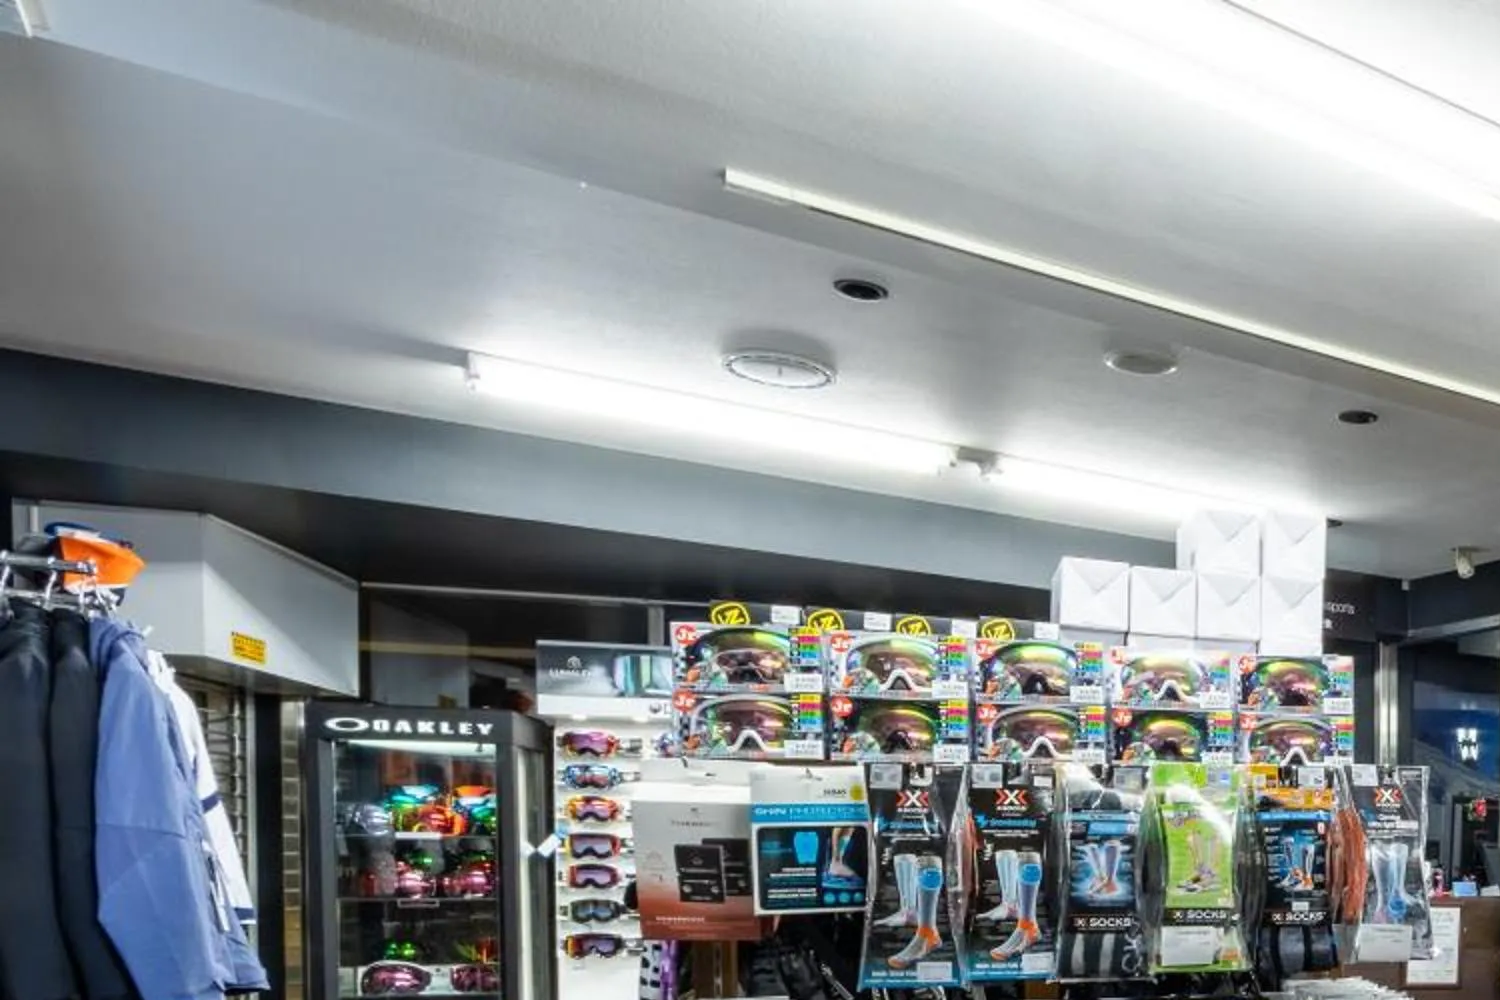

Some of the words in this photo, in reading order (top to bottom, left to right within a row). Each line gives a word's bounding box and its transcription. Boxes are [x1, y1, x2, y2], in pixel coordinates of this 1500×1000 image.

[372, 718, 494, 736] OAKLEY
[1186, 910, 1227, 920] SOCKS
[1285, 912, 1325, 922] SOCKS
[1089, 917, 1132, 927] SOCKS
